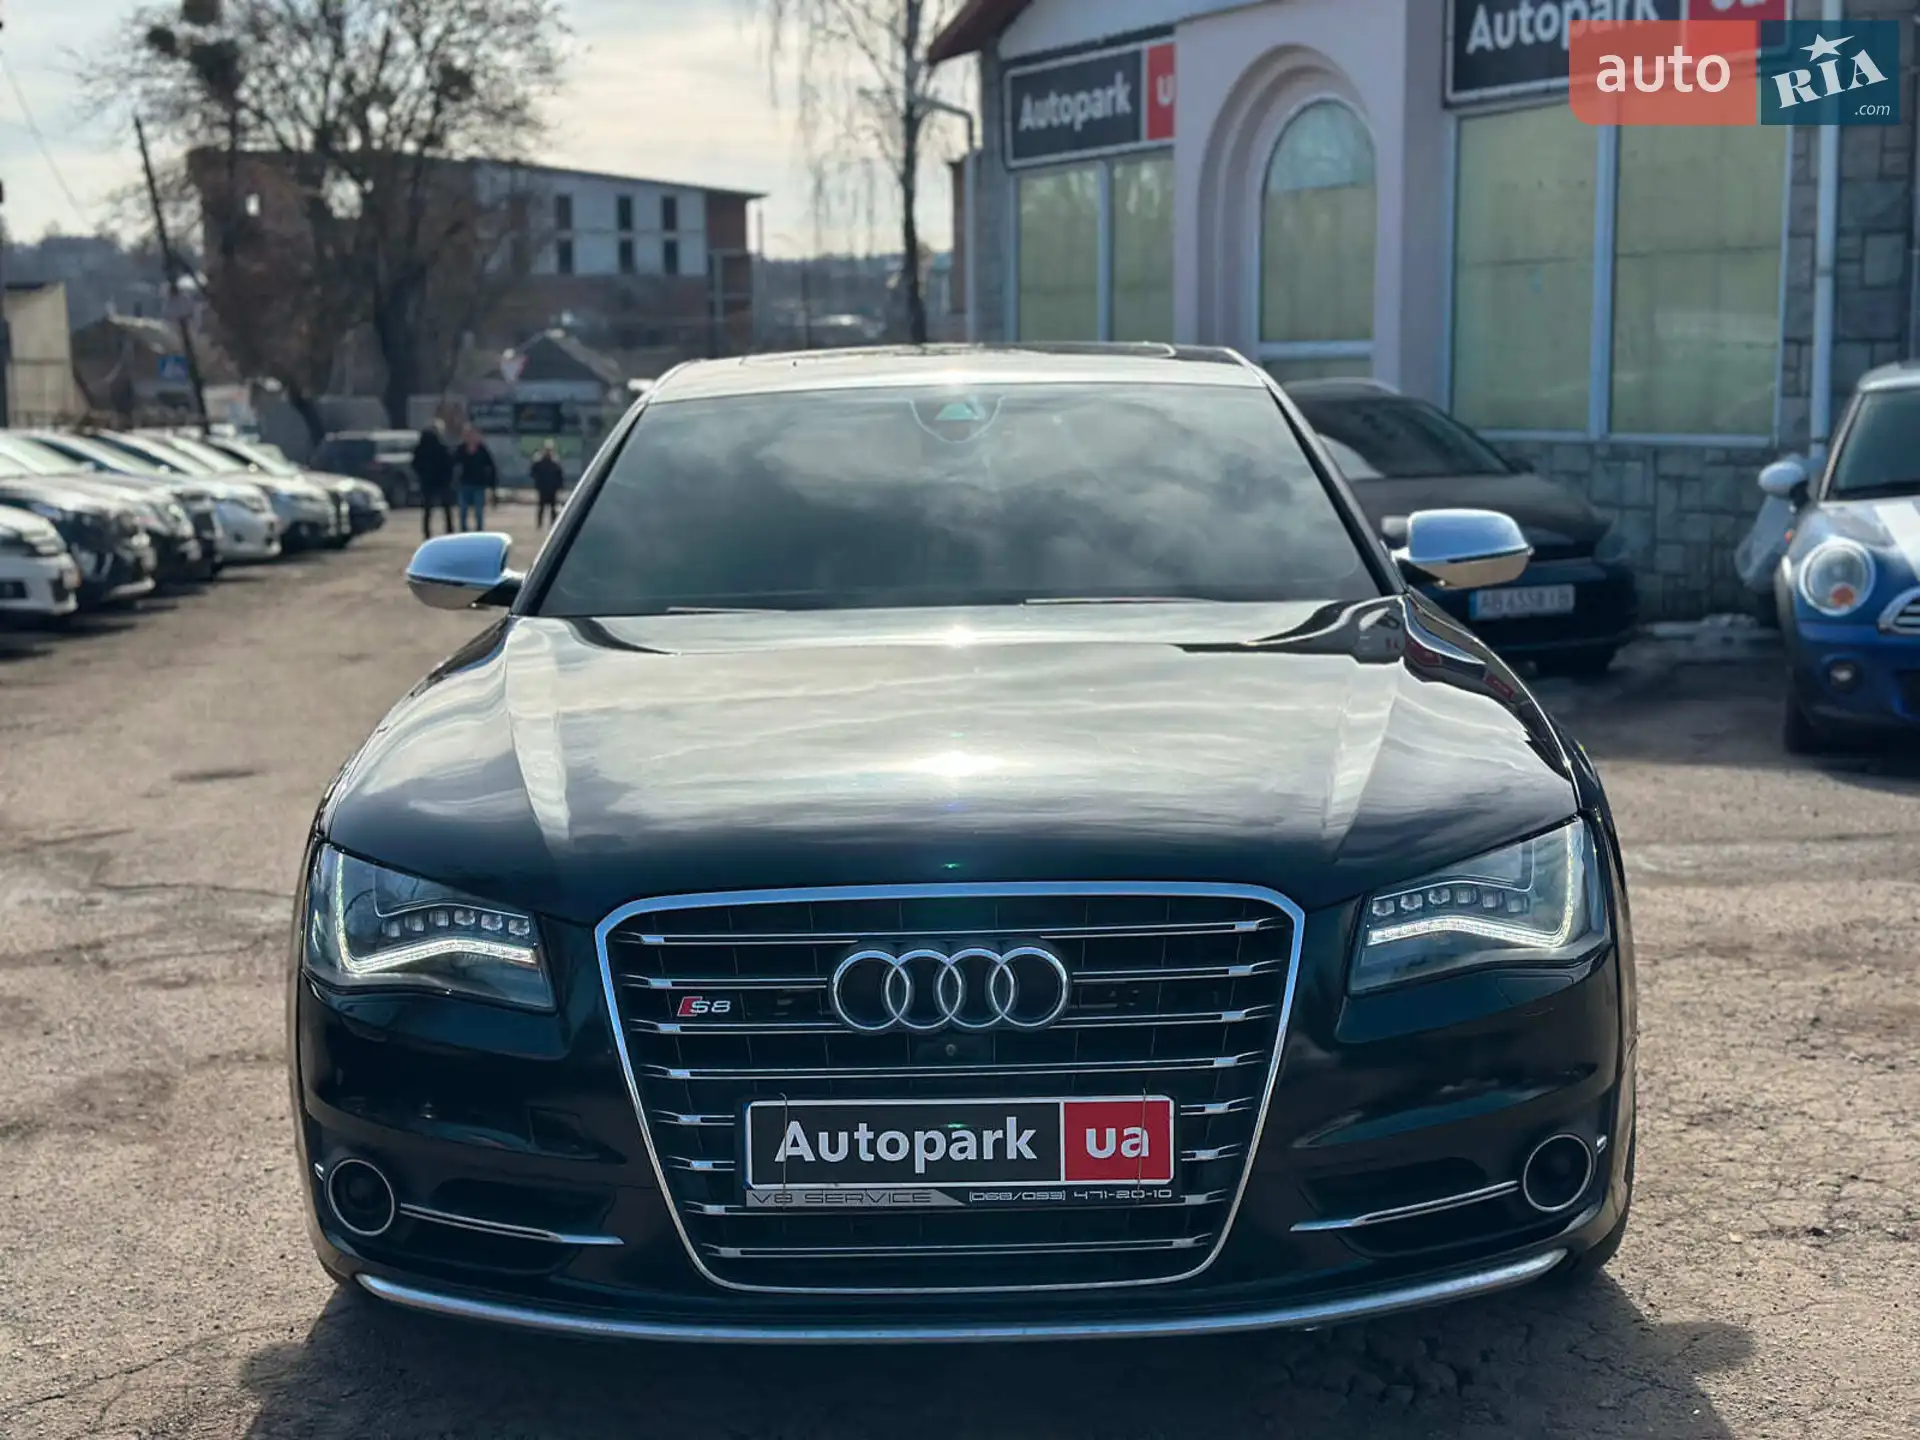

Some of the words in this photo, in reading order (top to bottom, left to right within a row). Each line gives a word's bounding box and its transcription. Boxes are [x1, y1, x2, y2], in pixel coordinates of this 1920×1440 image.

[1465, 0, 1660, 54] Autopark
[1018, 71, 1132, 132] Autopark
[690, 1000, 731, 1013] S8
[774, 1117, 1037, 1174] Autopark
[1085, 1126, 1150, 1158] ua
[752, 1193, 792, 1204] V8
[805, 1193, 931, 1205] SERVICE
[1074, 1189, 1172, 1201] 471-20-10
